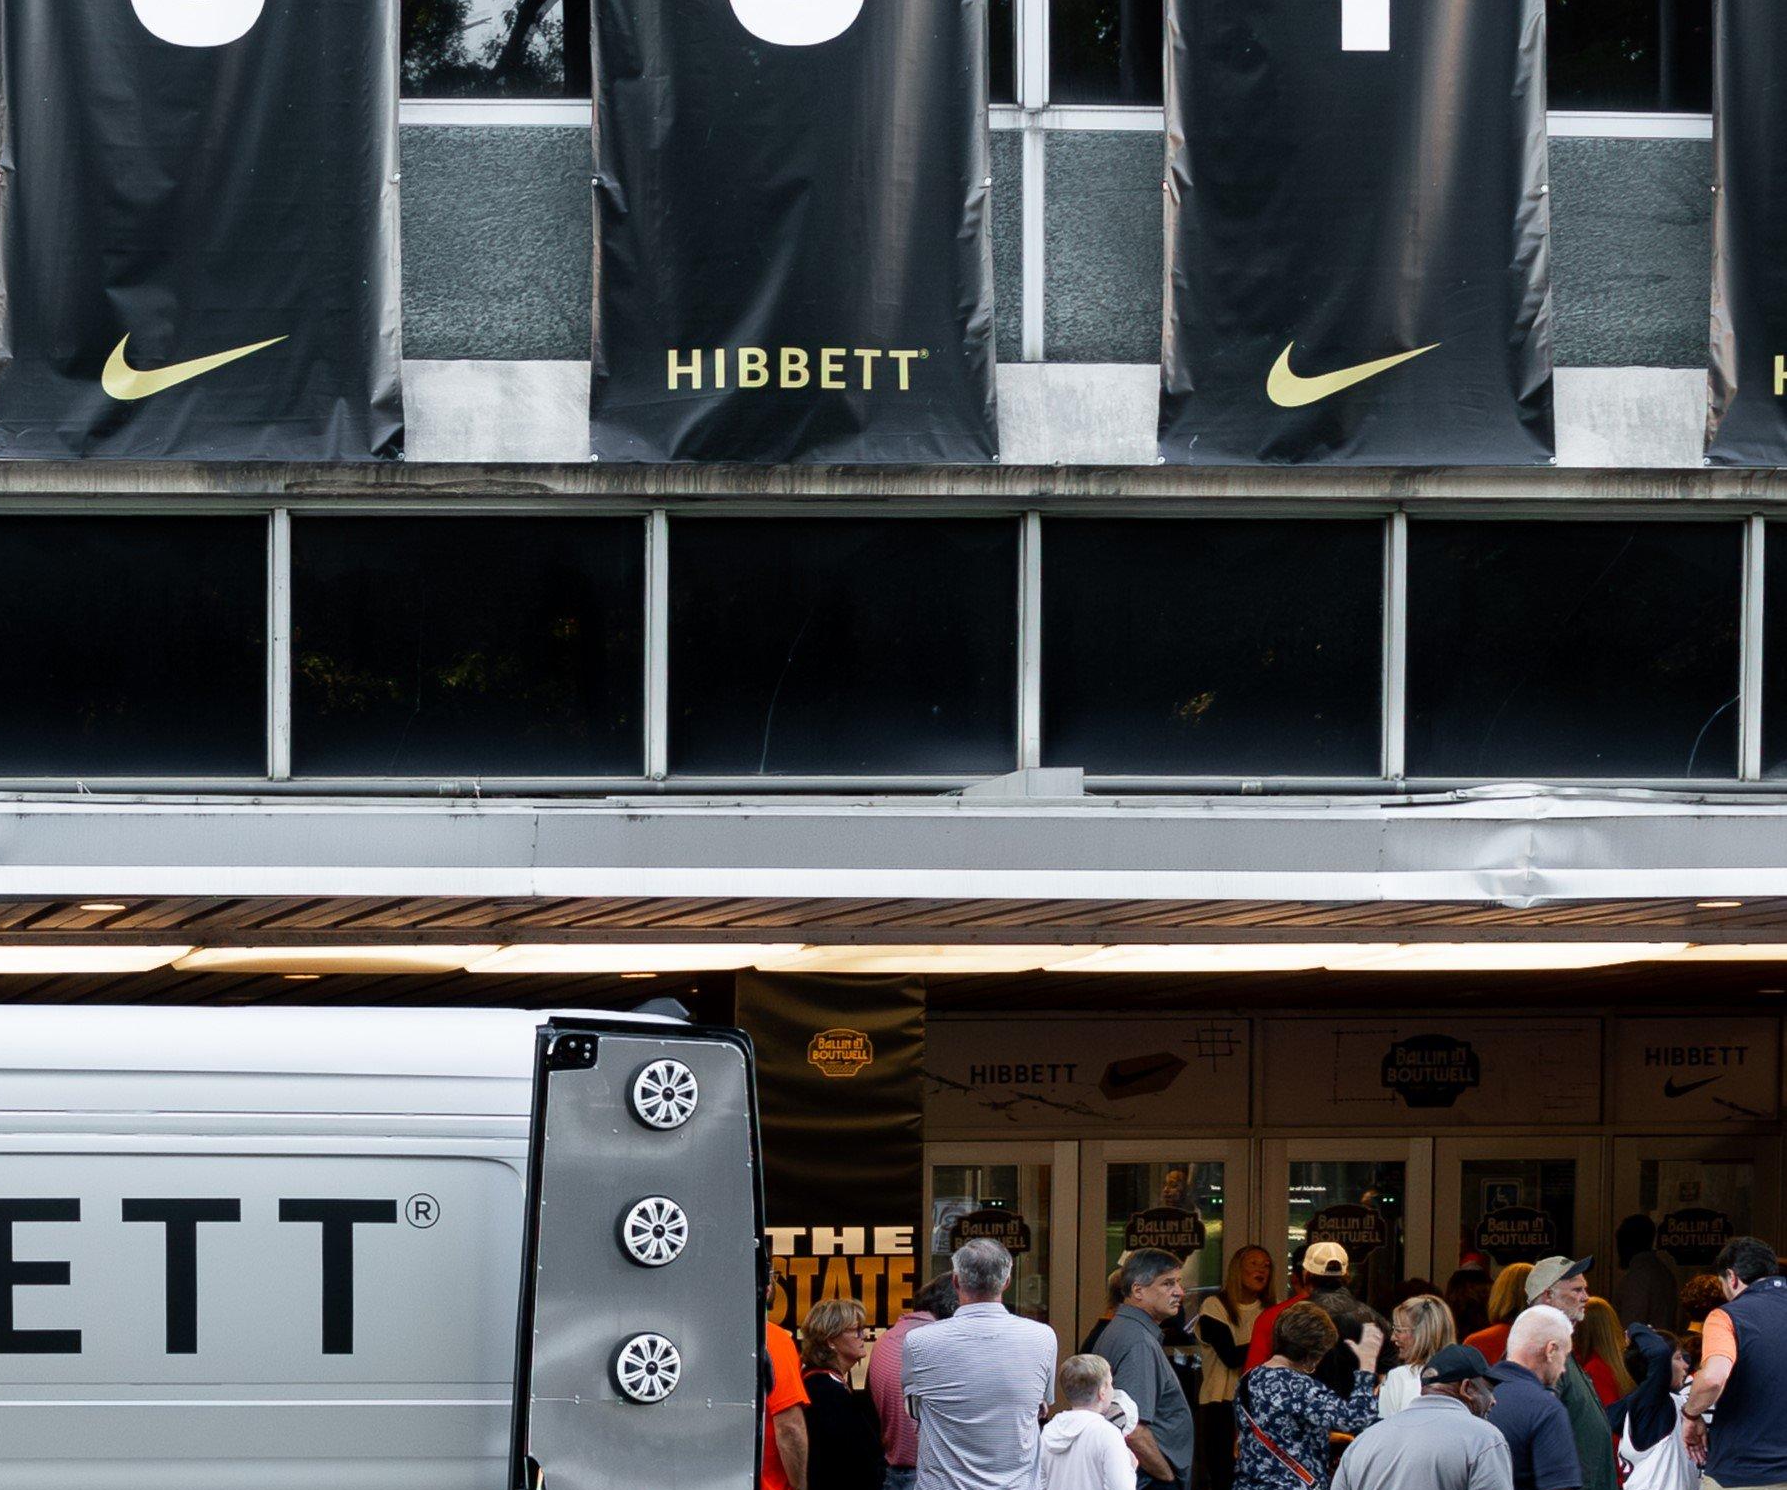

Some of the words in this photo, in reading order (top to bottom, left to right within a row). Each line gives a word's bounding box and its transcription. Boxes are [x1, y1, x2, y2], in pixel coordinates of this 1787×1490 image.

[1645, 1047, 1748, 1066] HIBBETT
[970, 1064, 1077, 1084] HIBBETT
[1387, 1067, 1475, 1082] BOUTWELL
[764, 1226, 914, 1255] THE
[1130, 1233, 1200, 1246] BOUTWELL
